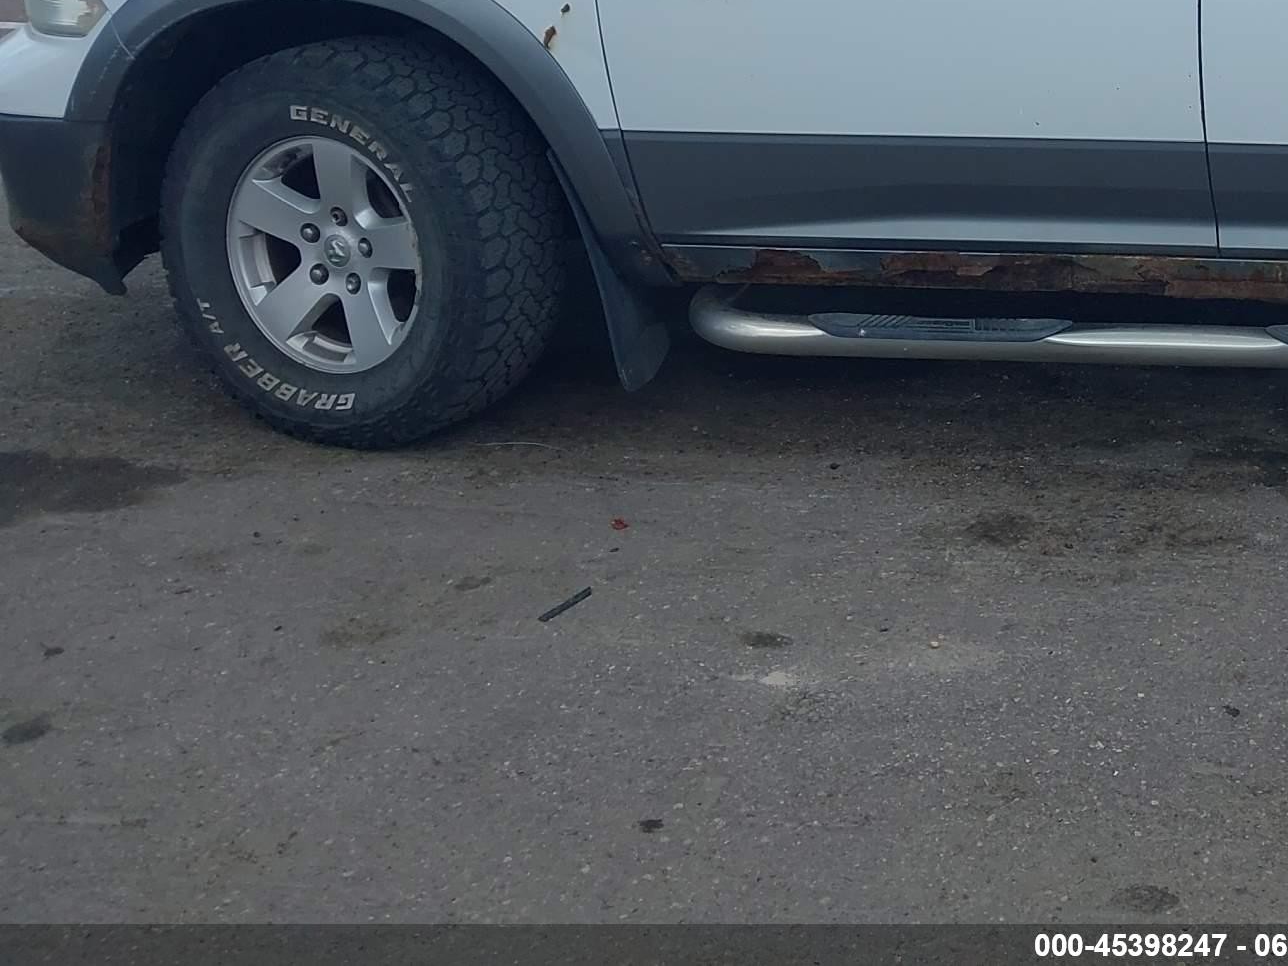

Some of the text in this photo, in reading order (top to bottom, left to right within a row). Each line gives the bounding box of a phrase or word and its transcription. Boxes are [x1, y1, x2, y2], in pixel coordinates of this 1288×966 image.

[289, 105, 412, 203] GENERAL
[196, 297, 355, 410] GRABBER A/T
